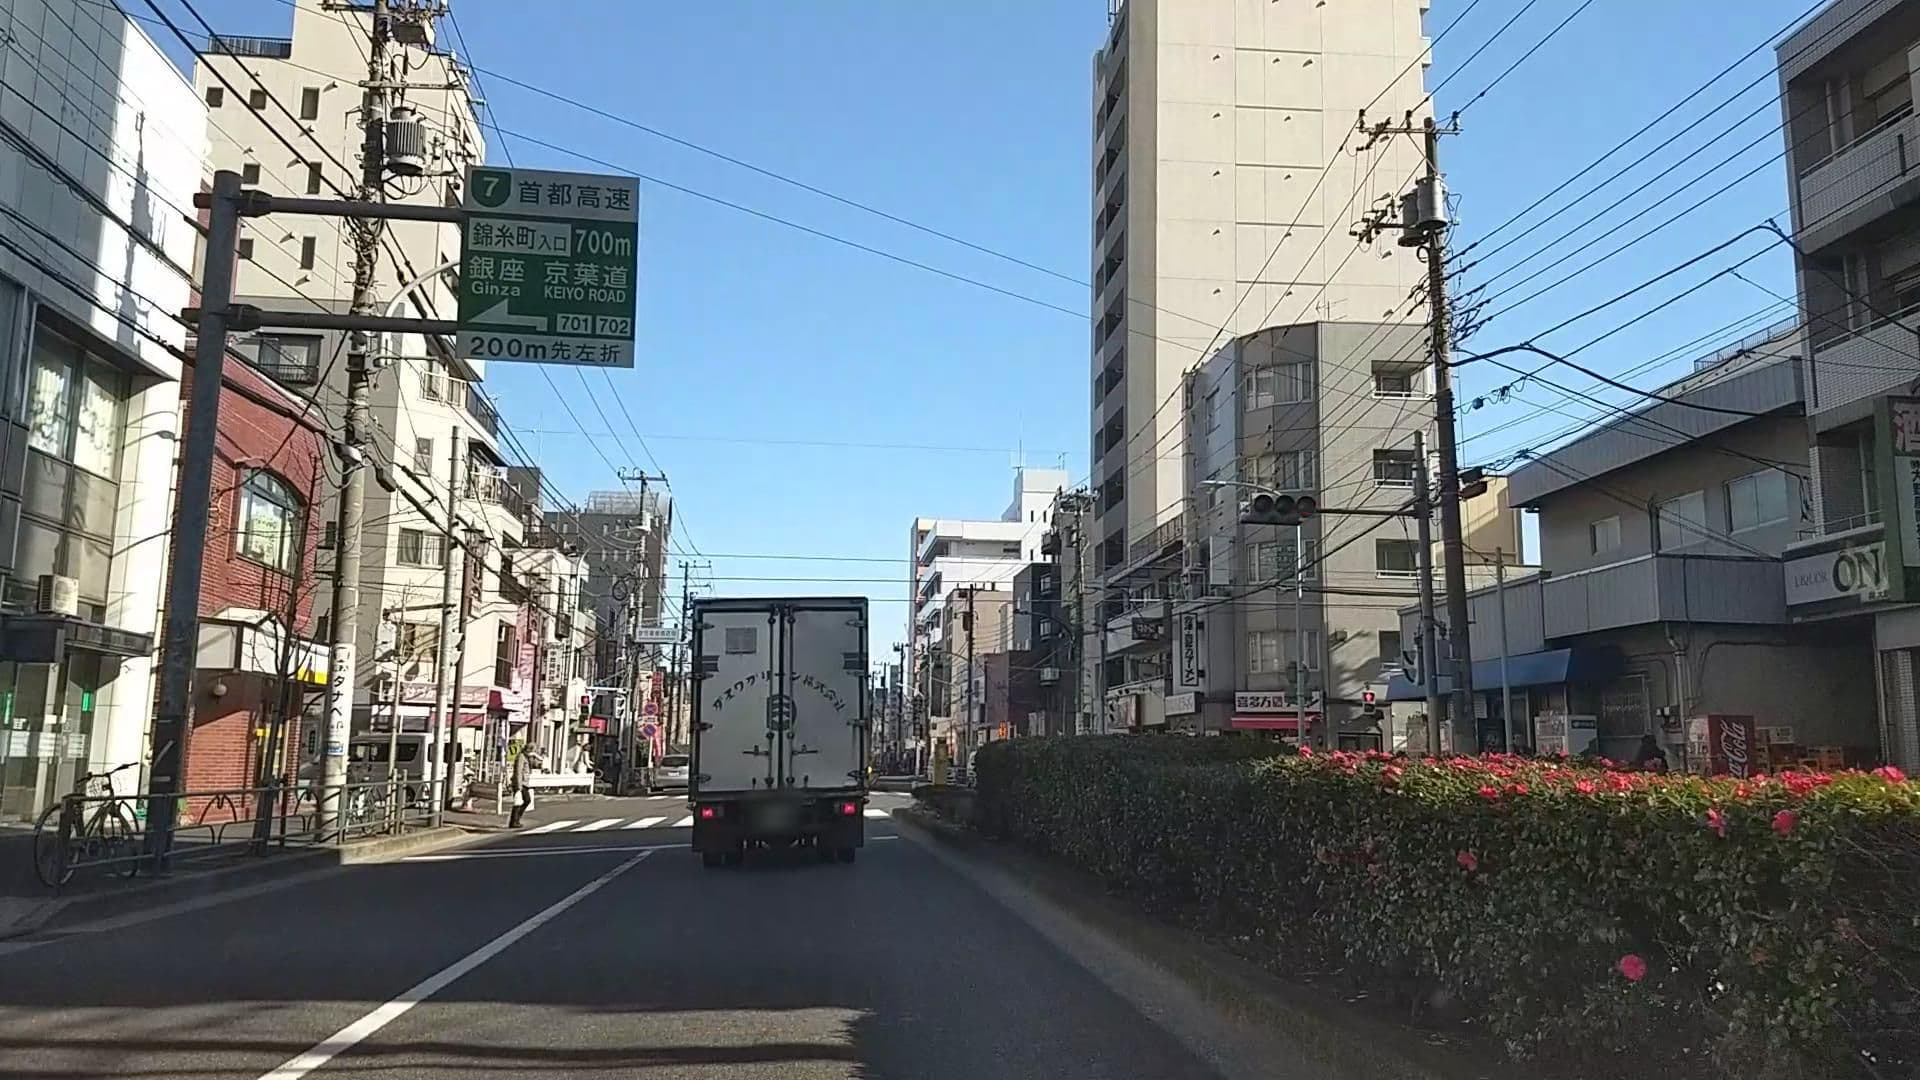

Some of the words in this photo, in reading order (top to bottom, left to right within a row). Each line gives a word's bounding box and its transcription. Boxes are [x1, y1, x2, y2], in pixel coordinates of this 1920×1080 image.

[483, 176, 499, 198] 7
[518, 180, 631, 211] 首都高速
[473, 222, 567, 252] 錦糸町入口
[575, 228, 631, 257] 700m
[469, 256, 526, 283] 銀座
[544, 261, 628, 289] 京葉道
[471, 281, 521, 297] Ginza
[544, 285, 585, 301] KEIYO
[588, 288, 626, 303] ROAD
[561, 316, 589, 331] 701
[599, 319, 628, 334] 702
[470, 337, 621, 363] 200m先左折
